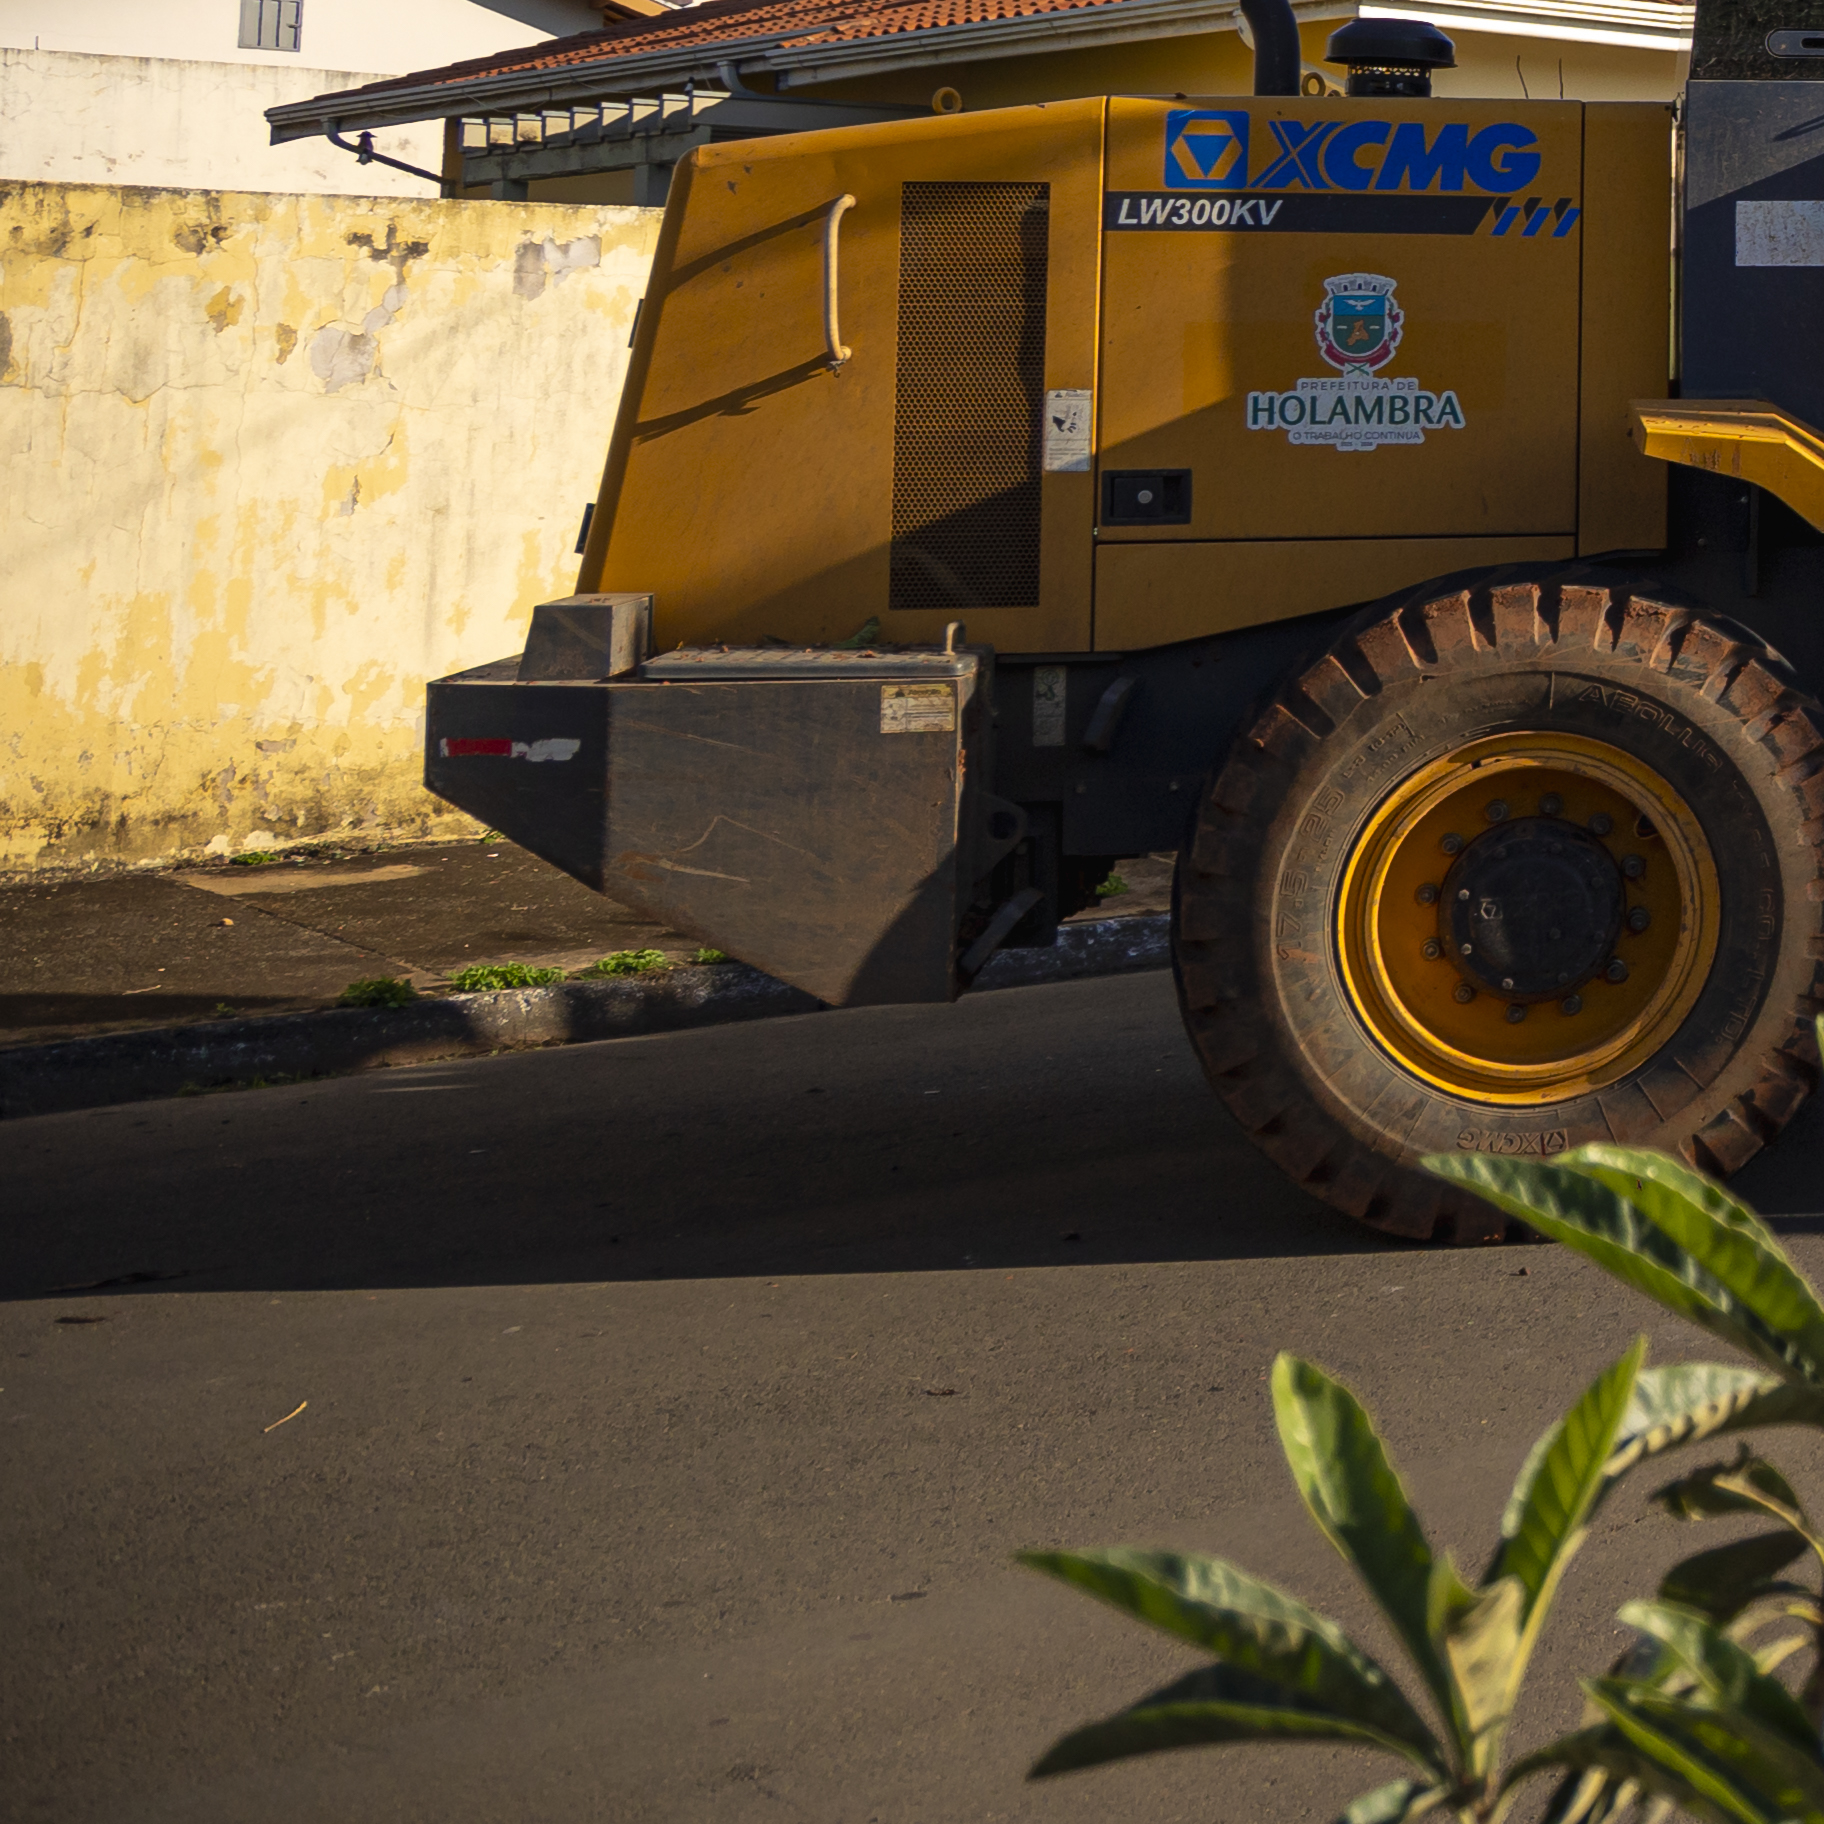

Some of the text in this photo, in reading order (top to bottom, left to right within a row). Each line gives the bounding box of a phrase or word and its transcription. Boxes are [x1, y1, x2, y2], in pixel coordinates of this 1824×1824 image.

[1249, 120, 1542, 193] XCMG
[1117, 198, 1284, 226] LW300KV
[1300, 381, 1416, 391] PREFEITURA DE
[1252, 395, 1462, 426] HOLAMBRA
[1293, 430, 1421, 441] O TRABALHO CONTINUA
[1455, 1127, 1540, 1155] XCMG
